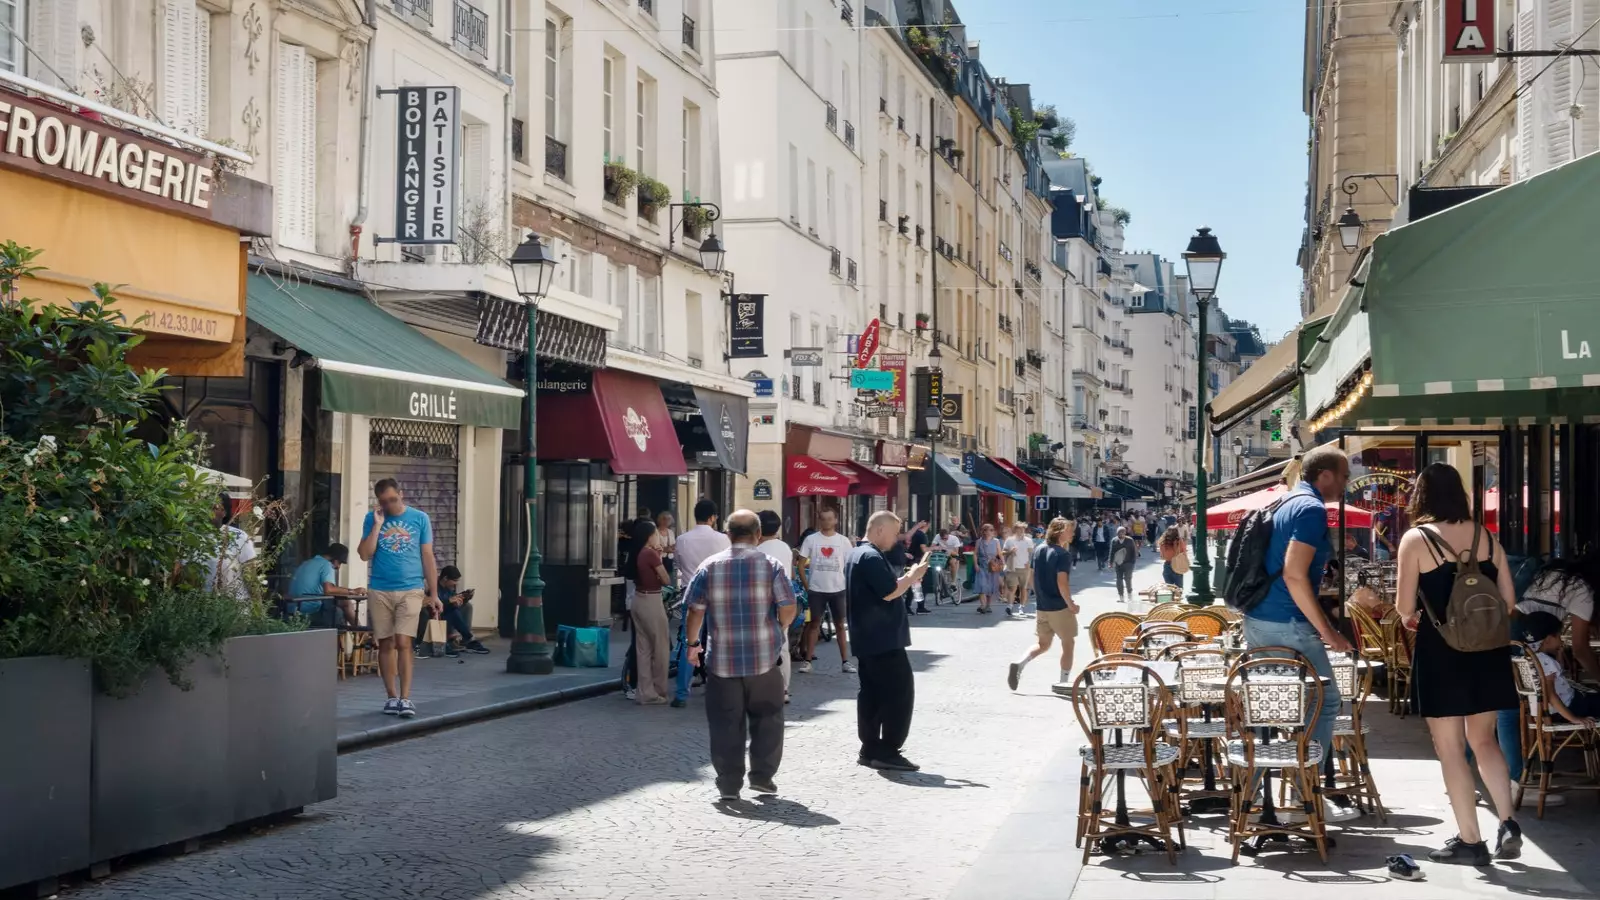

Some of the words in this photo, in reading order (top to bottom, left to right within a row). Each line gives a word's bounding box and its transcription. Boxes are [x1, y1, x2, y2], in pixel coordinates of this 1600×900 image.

[404, 91, 421, 238] BOULANGER
[432, 91, 448, 238] PATISSIER
[144, 310, 217, 336] 01.42.33.04.07
[861, 326, 876, 361] TABAC
[536, 380, 587, 392] ulangerie
[931, 375, 939, 406] FIRST
[409, 390, 457, 419] GRILLÉ
[793, 462, 808, 470] Bar
